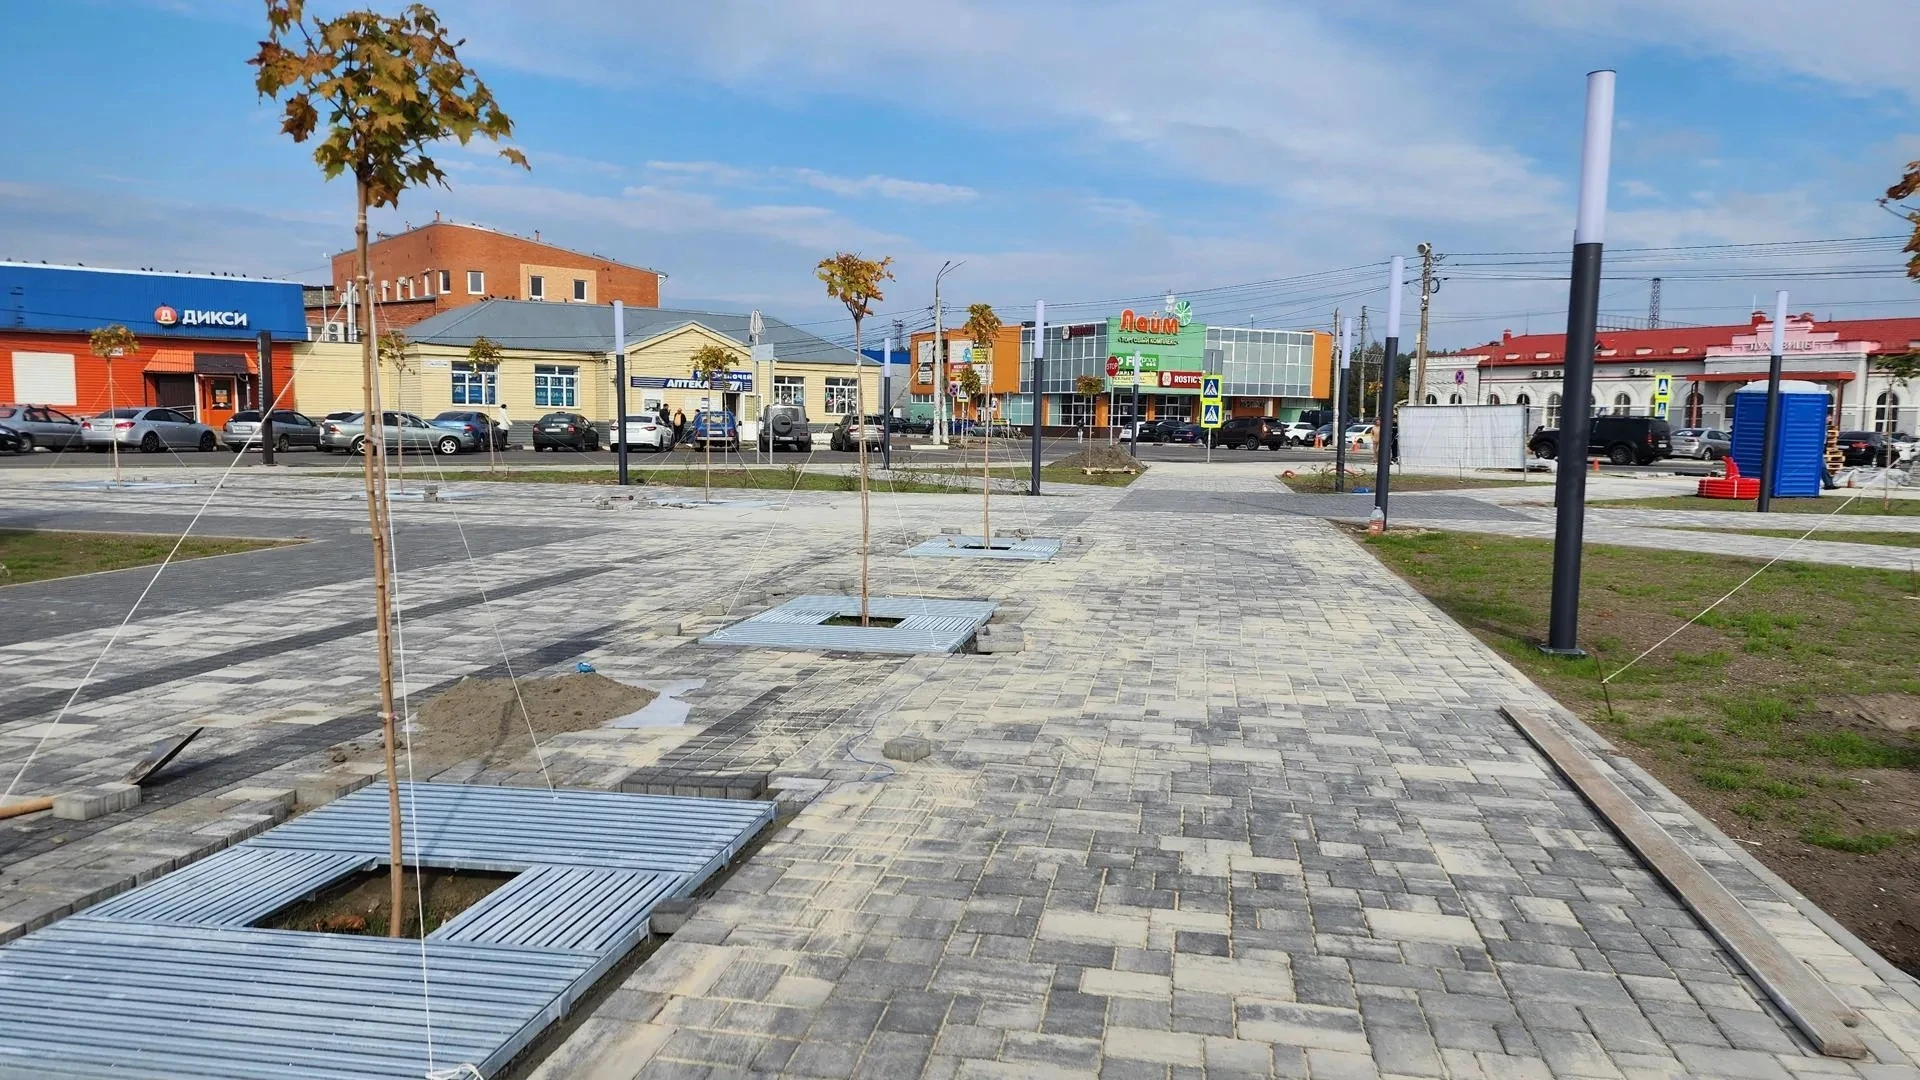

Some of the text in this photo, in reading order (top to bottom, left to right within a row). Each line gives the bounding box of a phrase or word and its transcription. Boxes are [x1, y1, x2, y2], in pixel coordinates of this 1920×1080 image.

[160, 309, 248, 326] Д ДИКСИ
[1119, 309, 1179, 335] Лайм
[1106, 362, 1118, 370] STOP
[666, 379, 710, 389] АПТЕКА
[1174, 375, 1202, 384] ROSTIC'S
